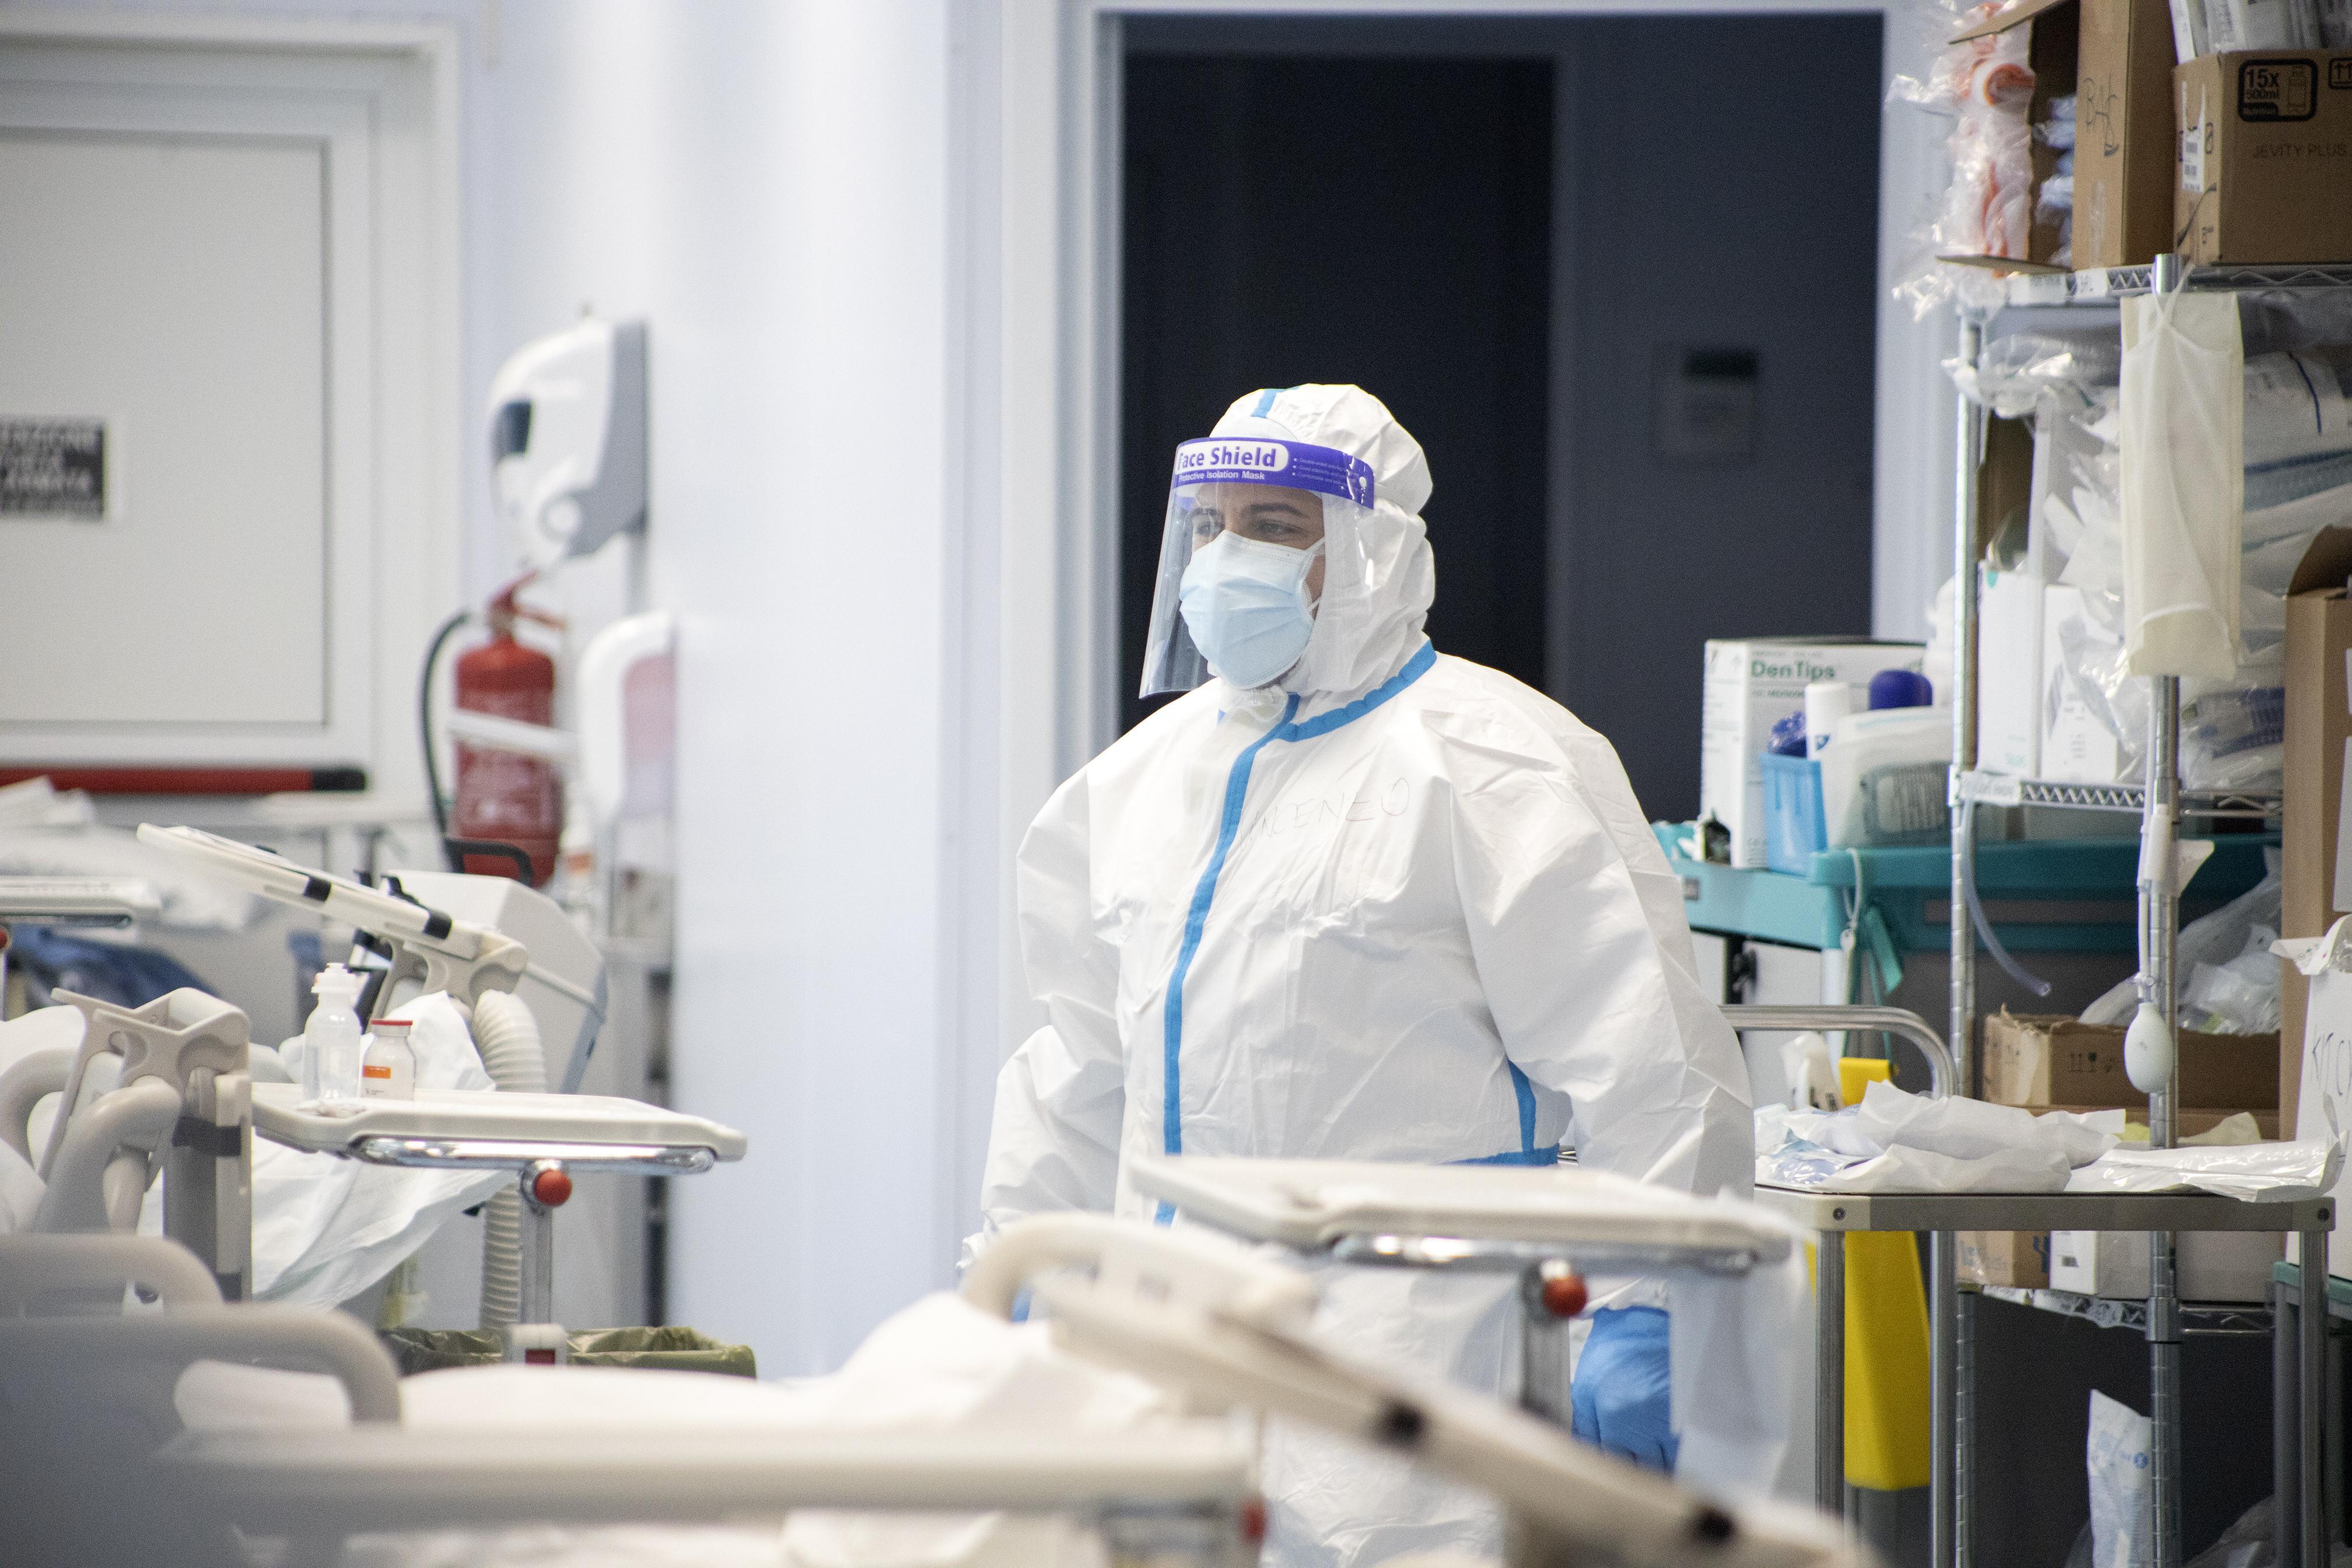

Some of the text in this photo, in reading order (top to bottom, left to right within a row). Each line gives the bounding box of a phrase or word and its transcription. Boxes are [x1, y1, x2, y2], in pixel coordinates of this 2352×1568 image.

[2246, 68, 2279, 88] 15x
[2252, 142, 2347, 158] JEVITY PLUS
[1177, 446, 1276, 471] Face Shield
[1178, 470, 1265, 482] Protective Isolation Mask
[1751, 660, 1836, 681] DenTips
